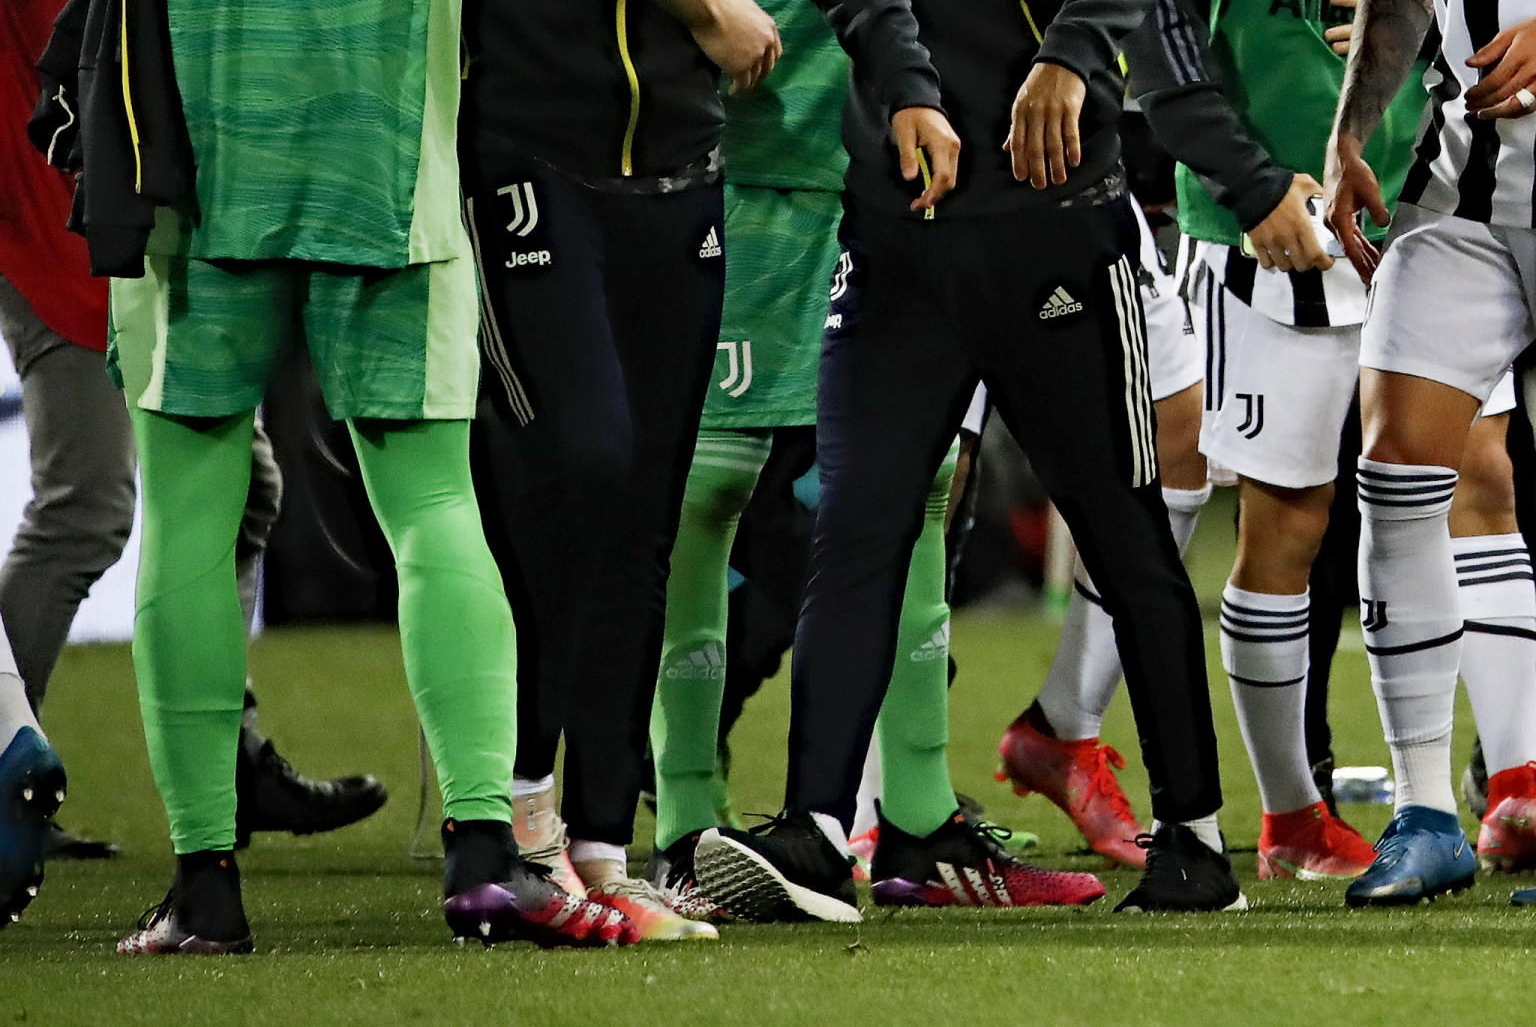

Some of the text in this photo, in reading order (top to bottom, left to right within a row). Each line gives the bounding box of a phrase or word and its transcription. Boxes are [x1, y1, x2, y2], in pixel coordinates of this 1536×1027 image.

[505, 250, 552, 269] Jeep
[699, 246, 722, 259] adidas
[1039, 301, 1083, 320] adidas
